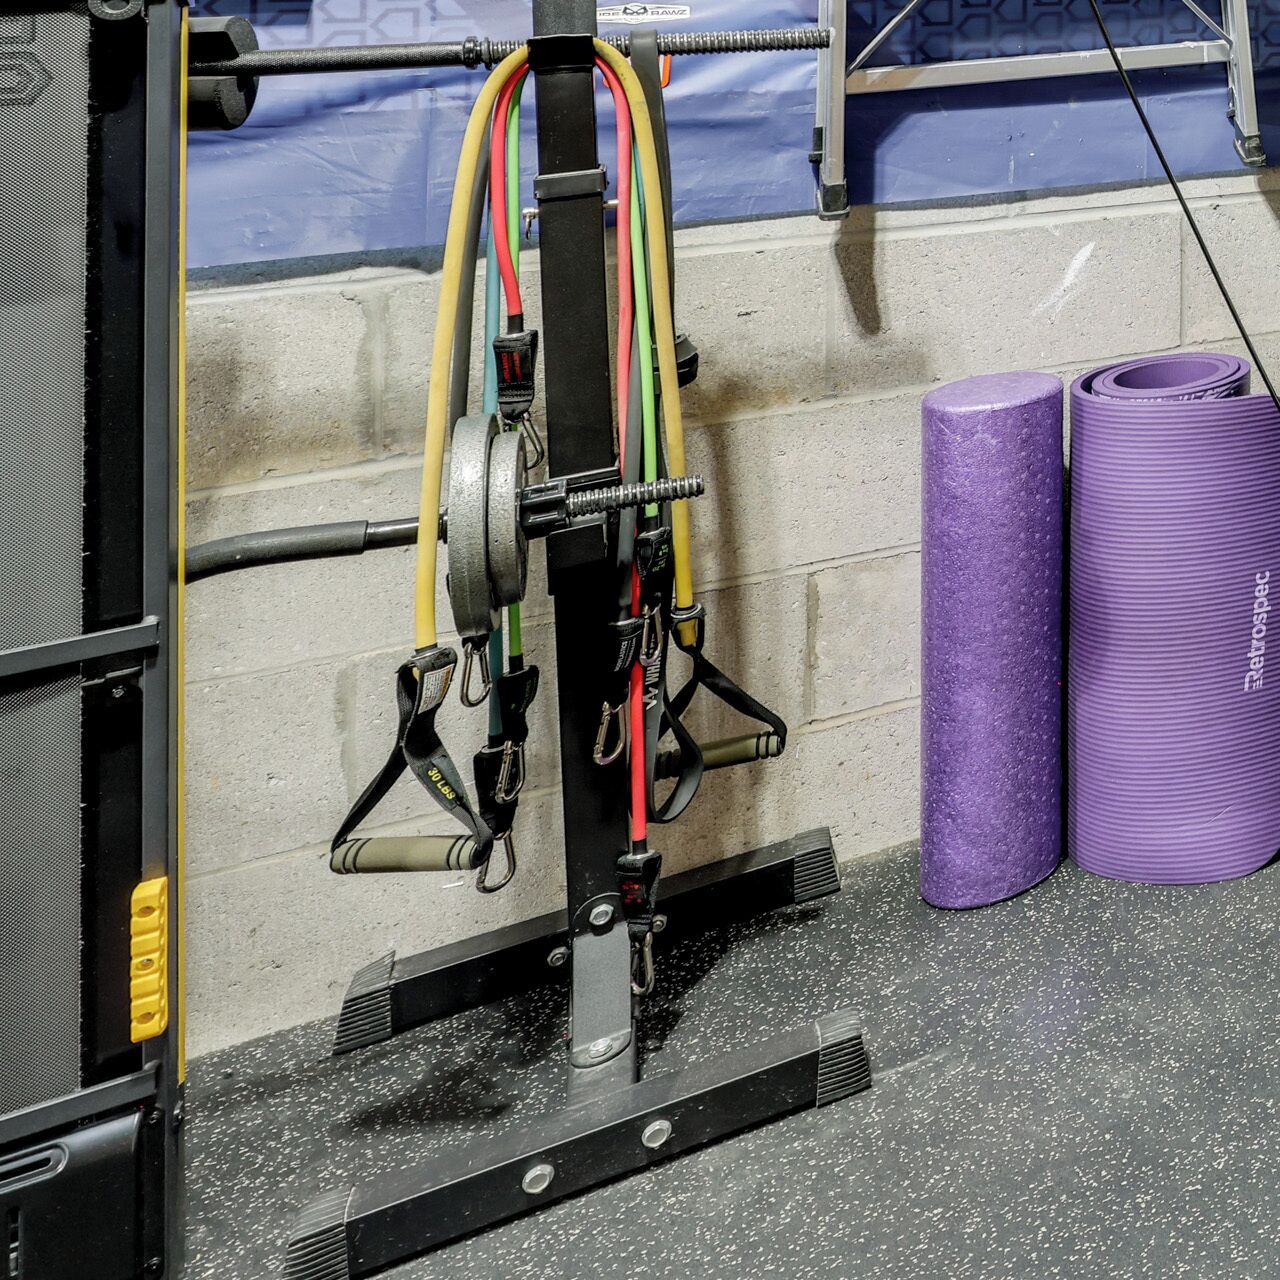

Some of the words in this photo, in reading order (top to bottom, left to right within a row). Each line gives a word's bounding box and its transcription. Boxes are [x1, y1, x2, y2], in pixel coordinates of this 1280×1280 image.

[1244, 570, 1271, 692] Retrospec
[427, 767, 441, 782] 30
[436, 780, 457, 801] LBS
